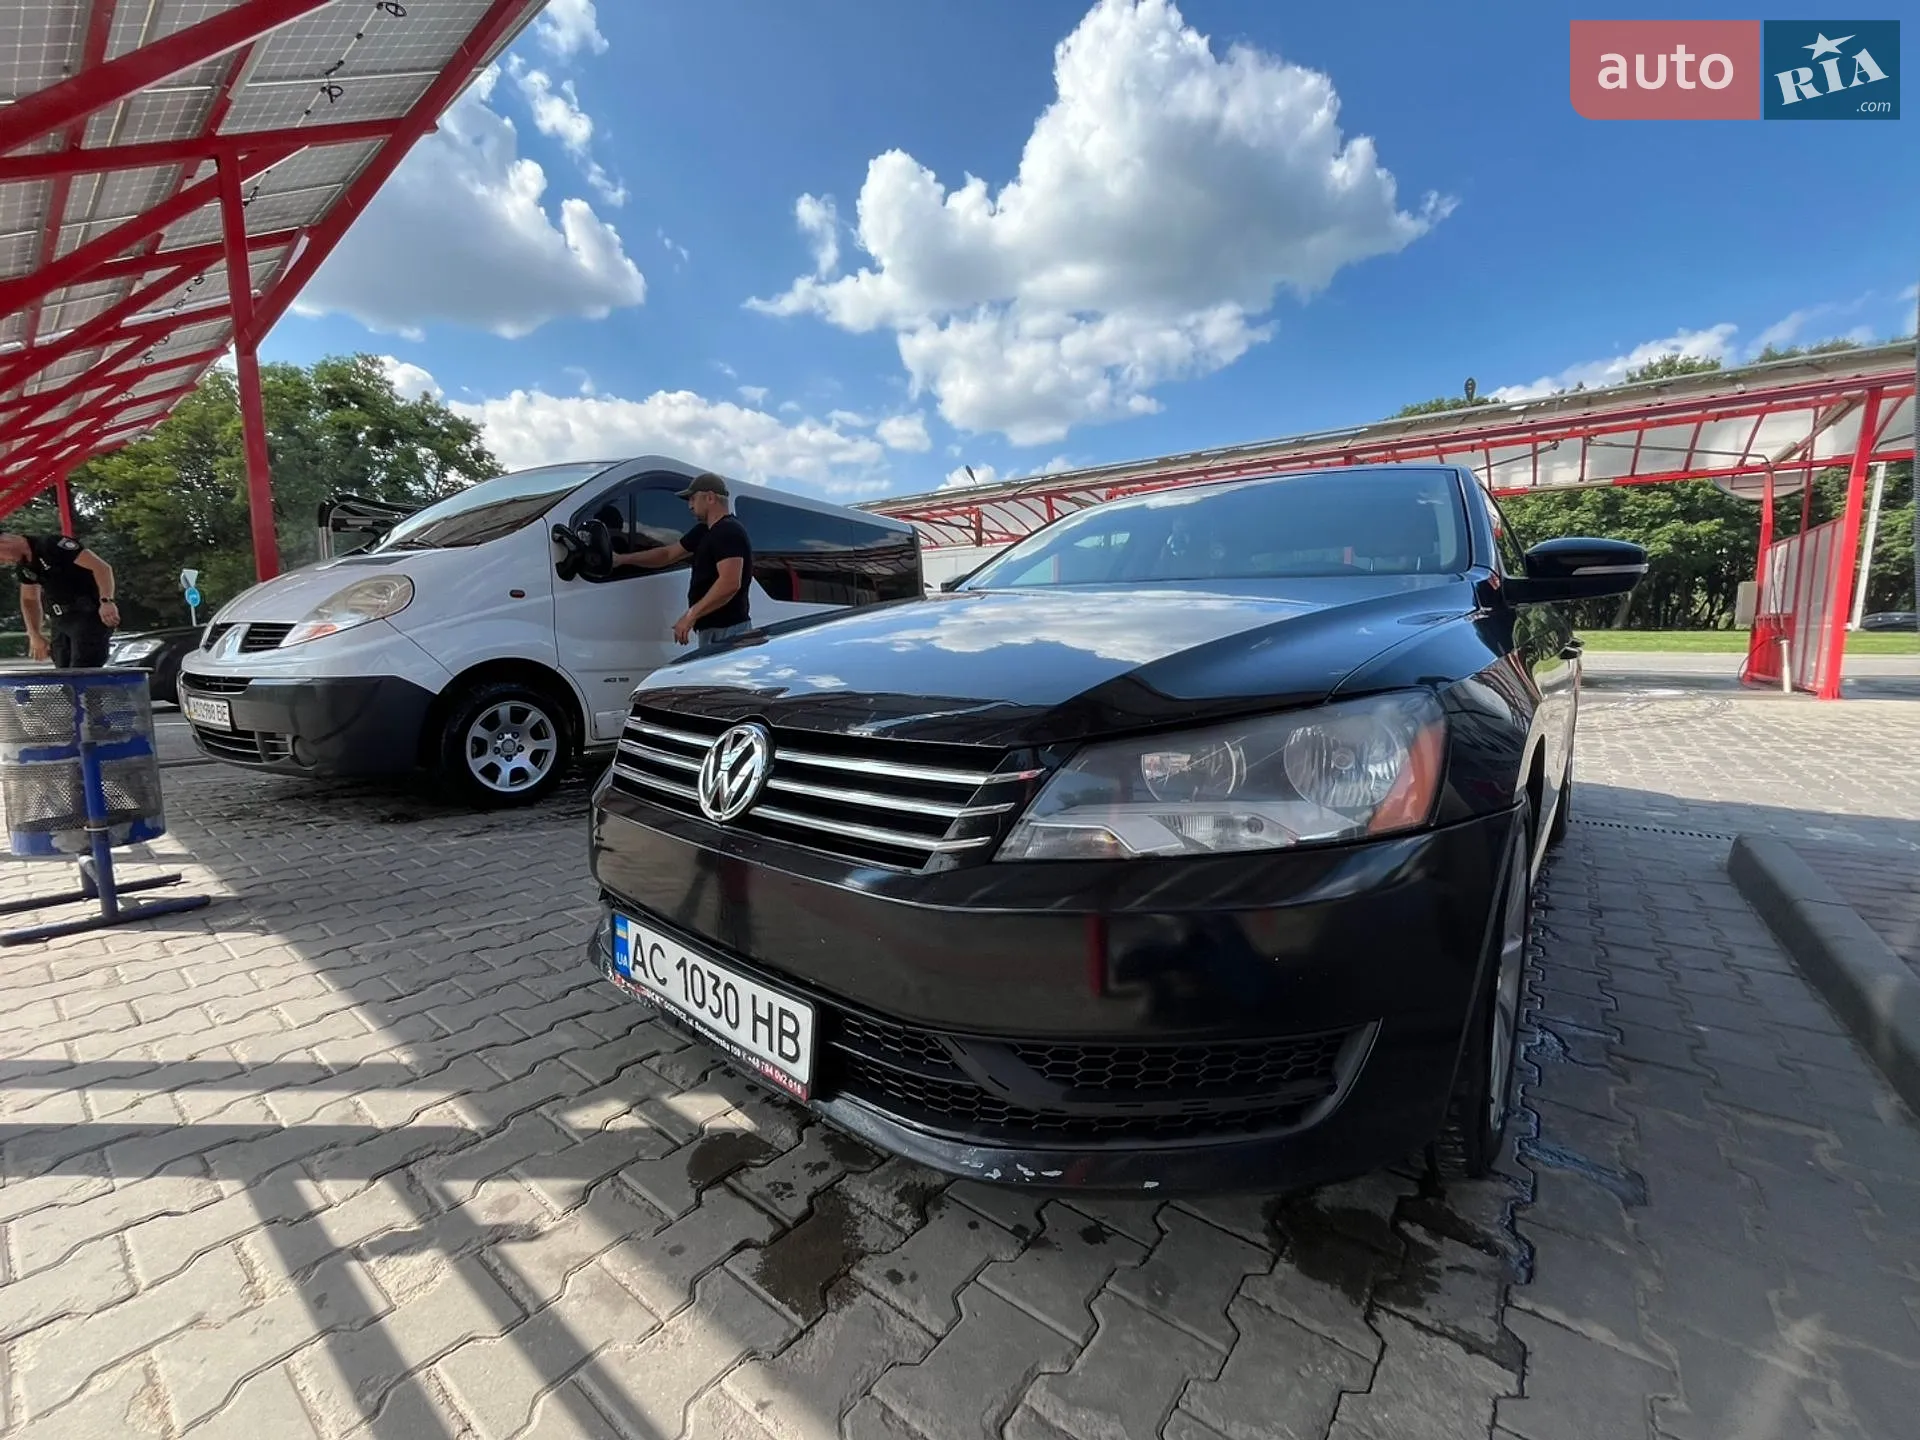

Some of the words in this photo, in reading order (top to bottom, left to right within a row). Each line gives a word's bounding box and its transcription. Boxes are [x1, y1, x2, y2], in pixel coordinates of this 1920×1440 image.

[616, 952, 628, 967] UA
[631, 933, 667, 986] AC
[676, 956, 740, 1031] 1030
[752, 994, 800, 1064] HB
